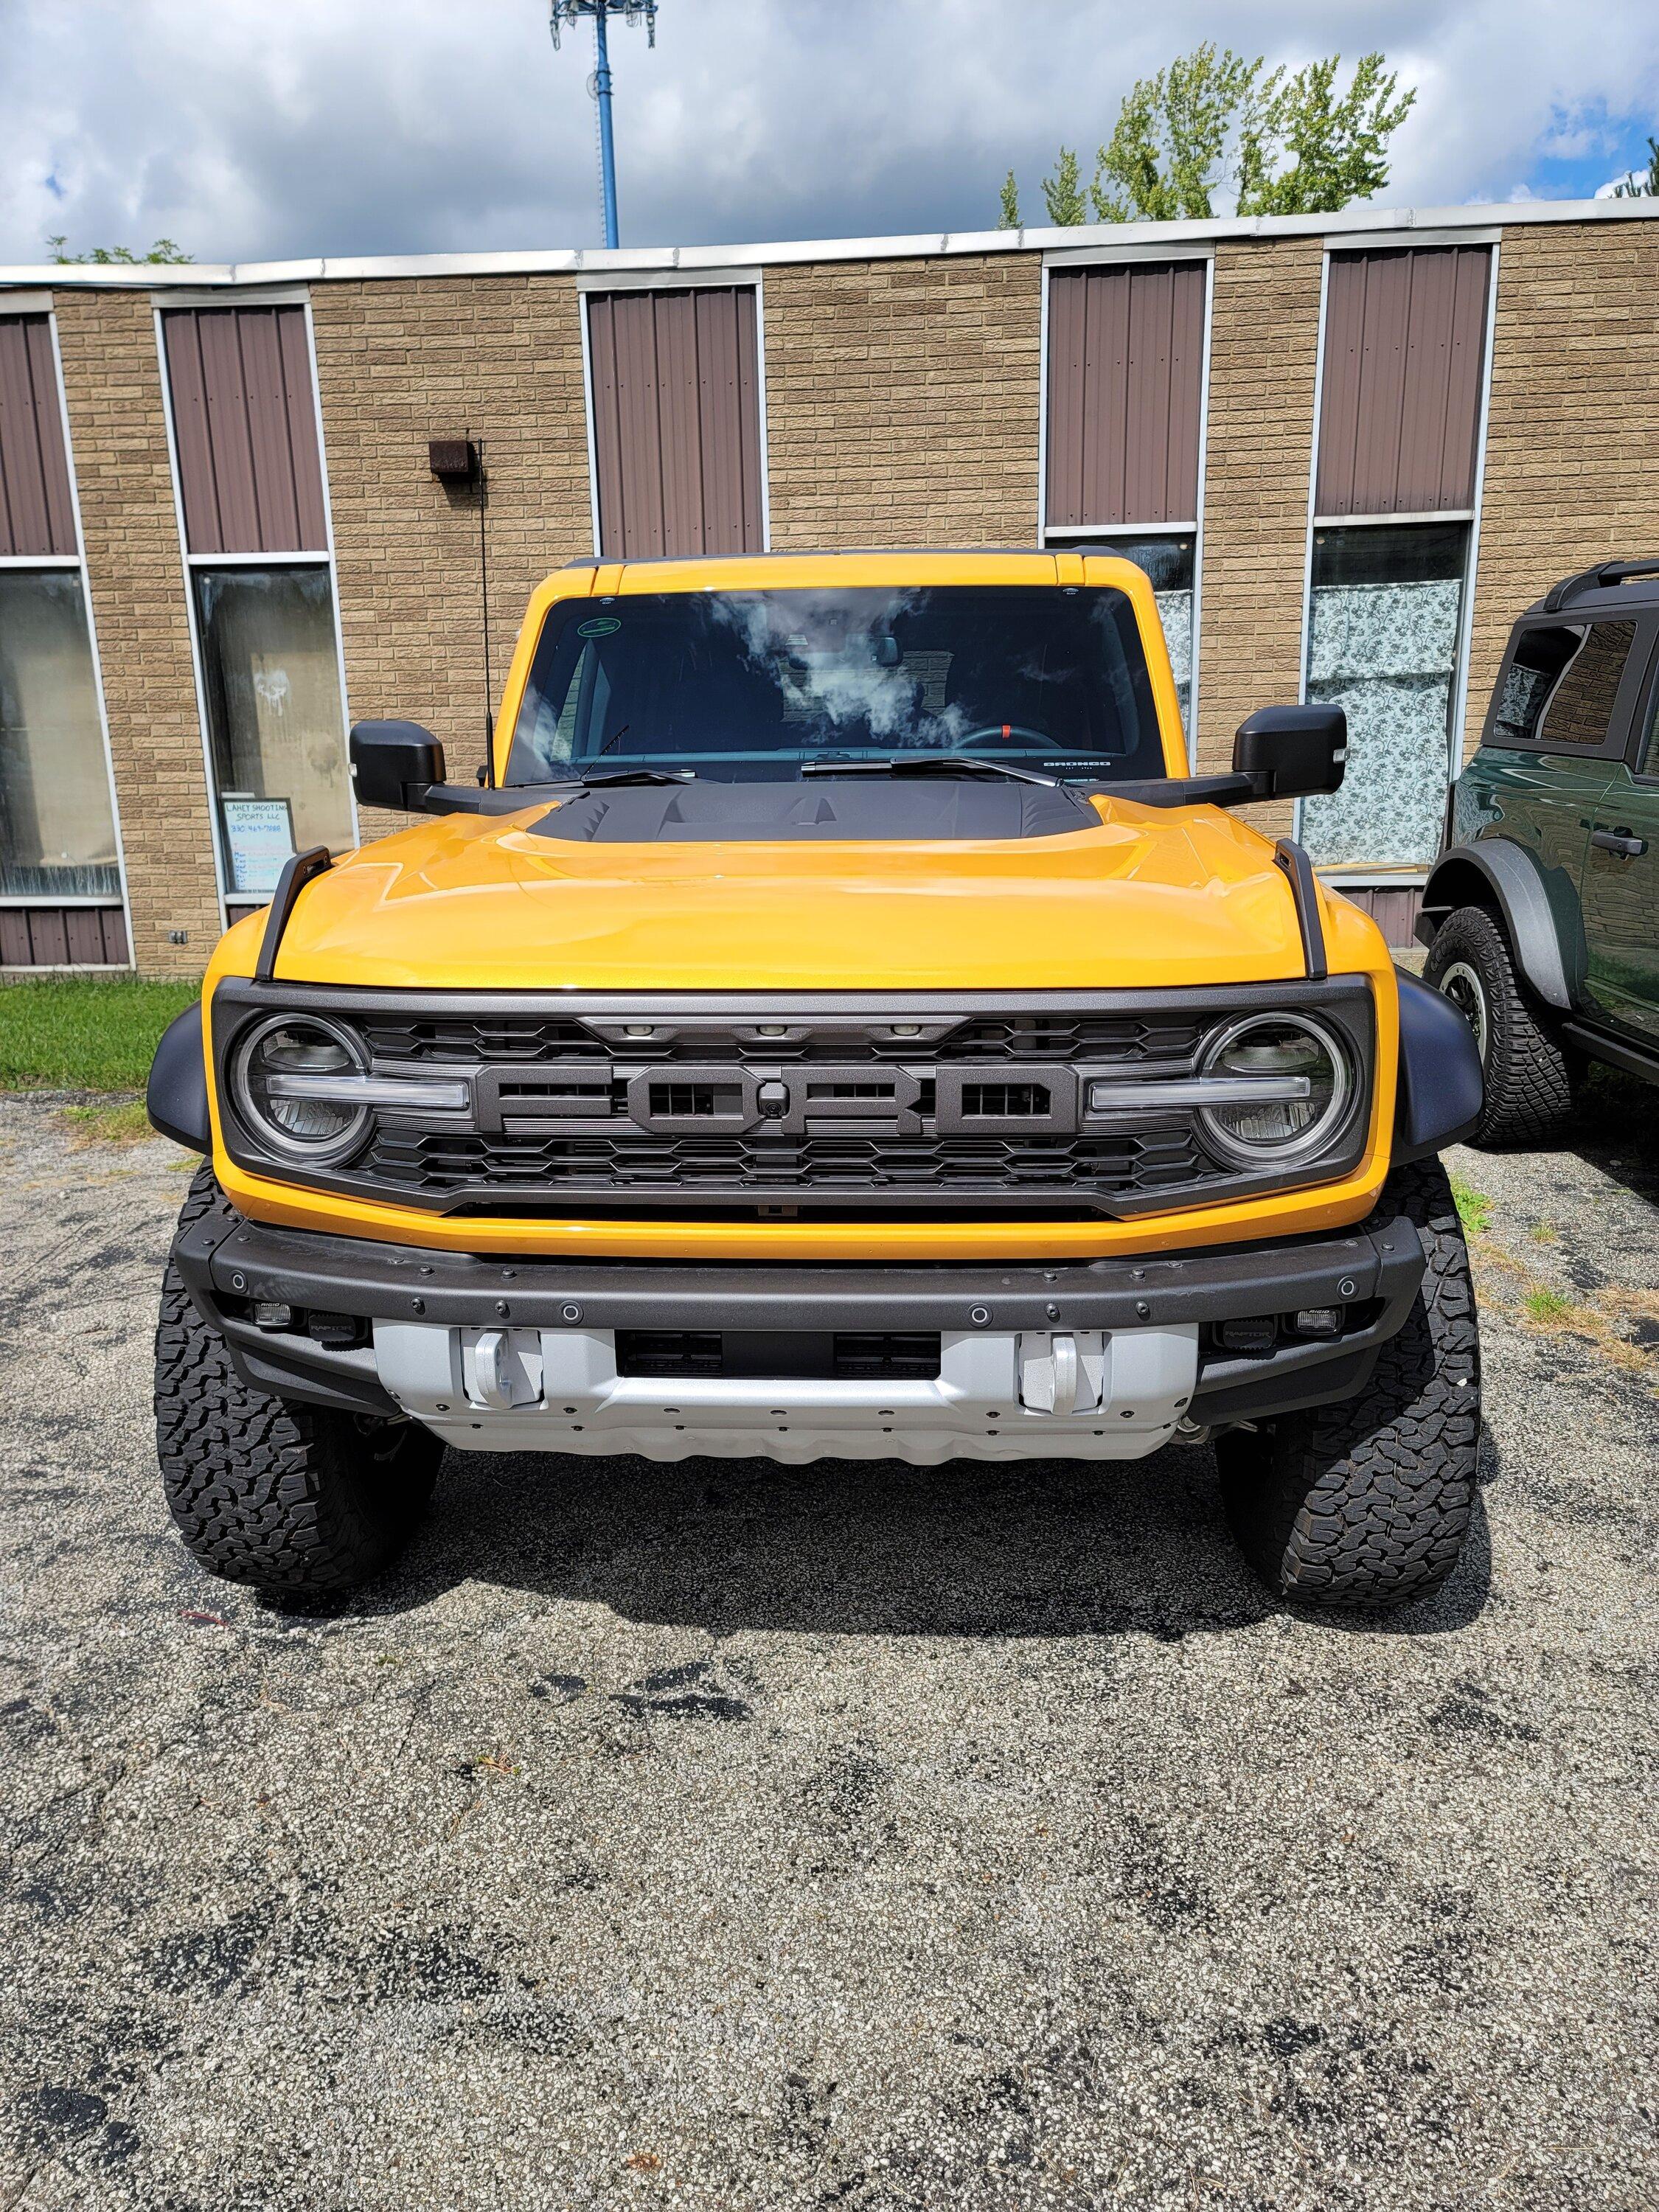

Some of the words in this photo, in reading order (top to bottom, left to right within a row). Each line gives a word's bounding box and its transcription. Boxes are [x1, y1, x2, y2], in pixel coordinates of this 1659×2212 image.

[236, 813, 263, 821] SPORTS
[476, 1065, 1079, 1135] FORD
[1225, 1330, 1271, 1338] RAPTOR
